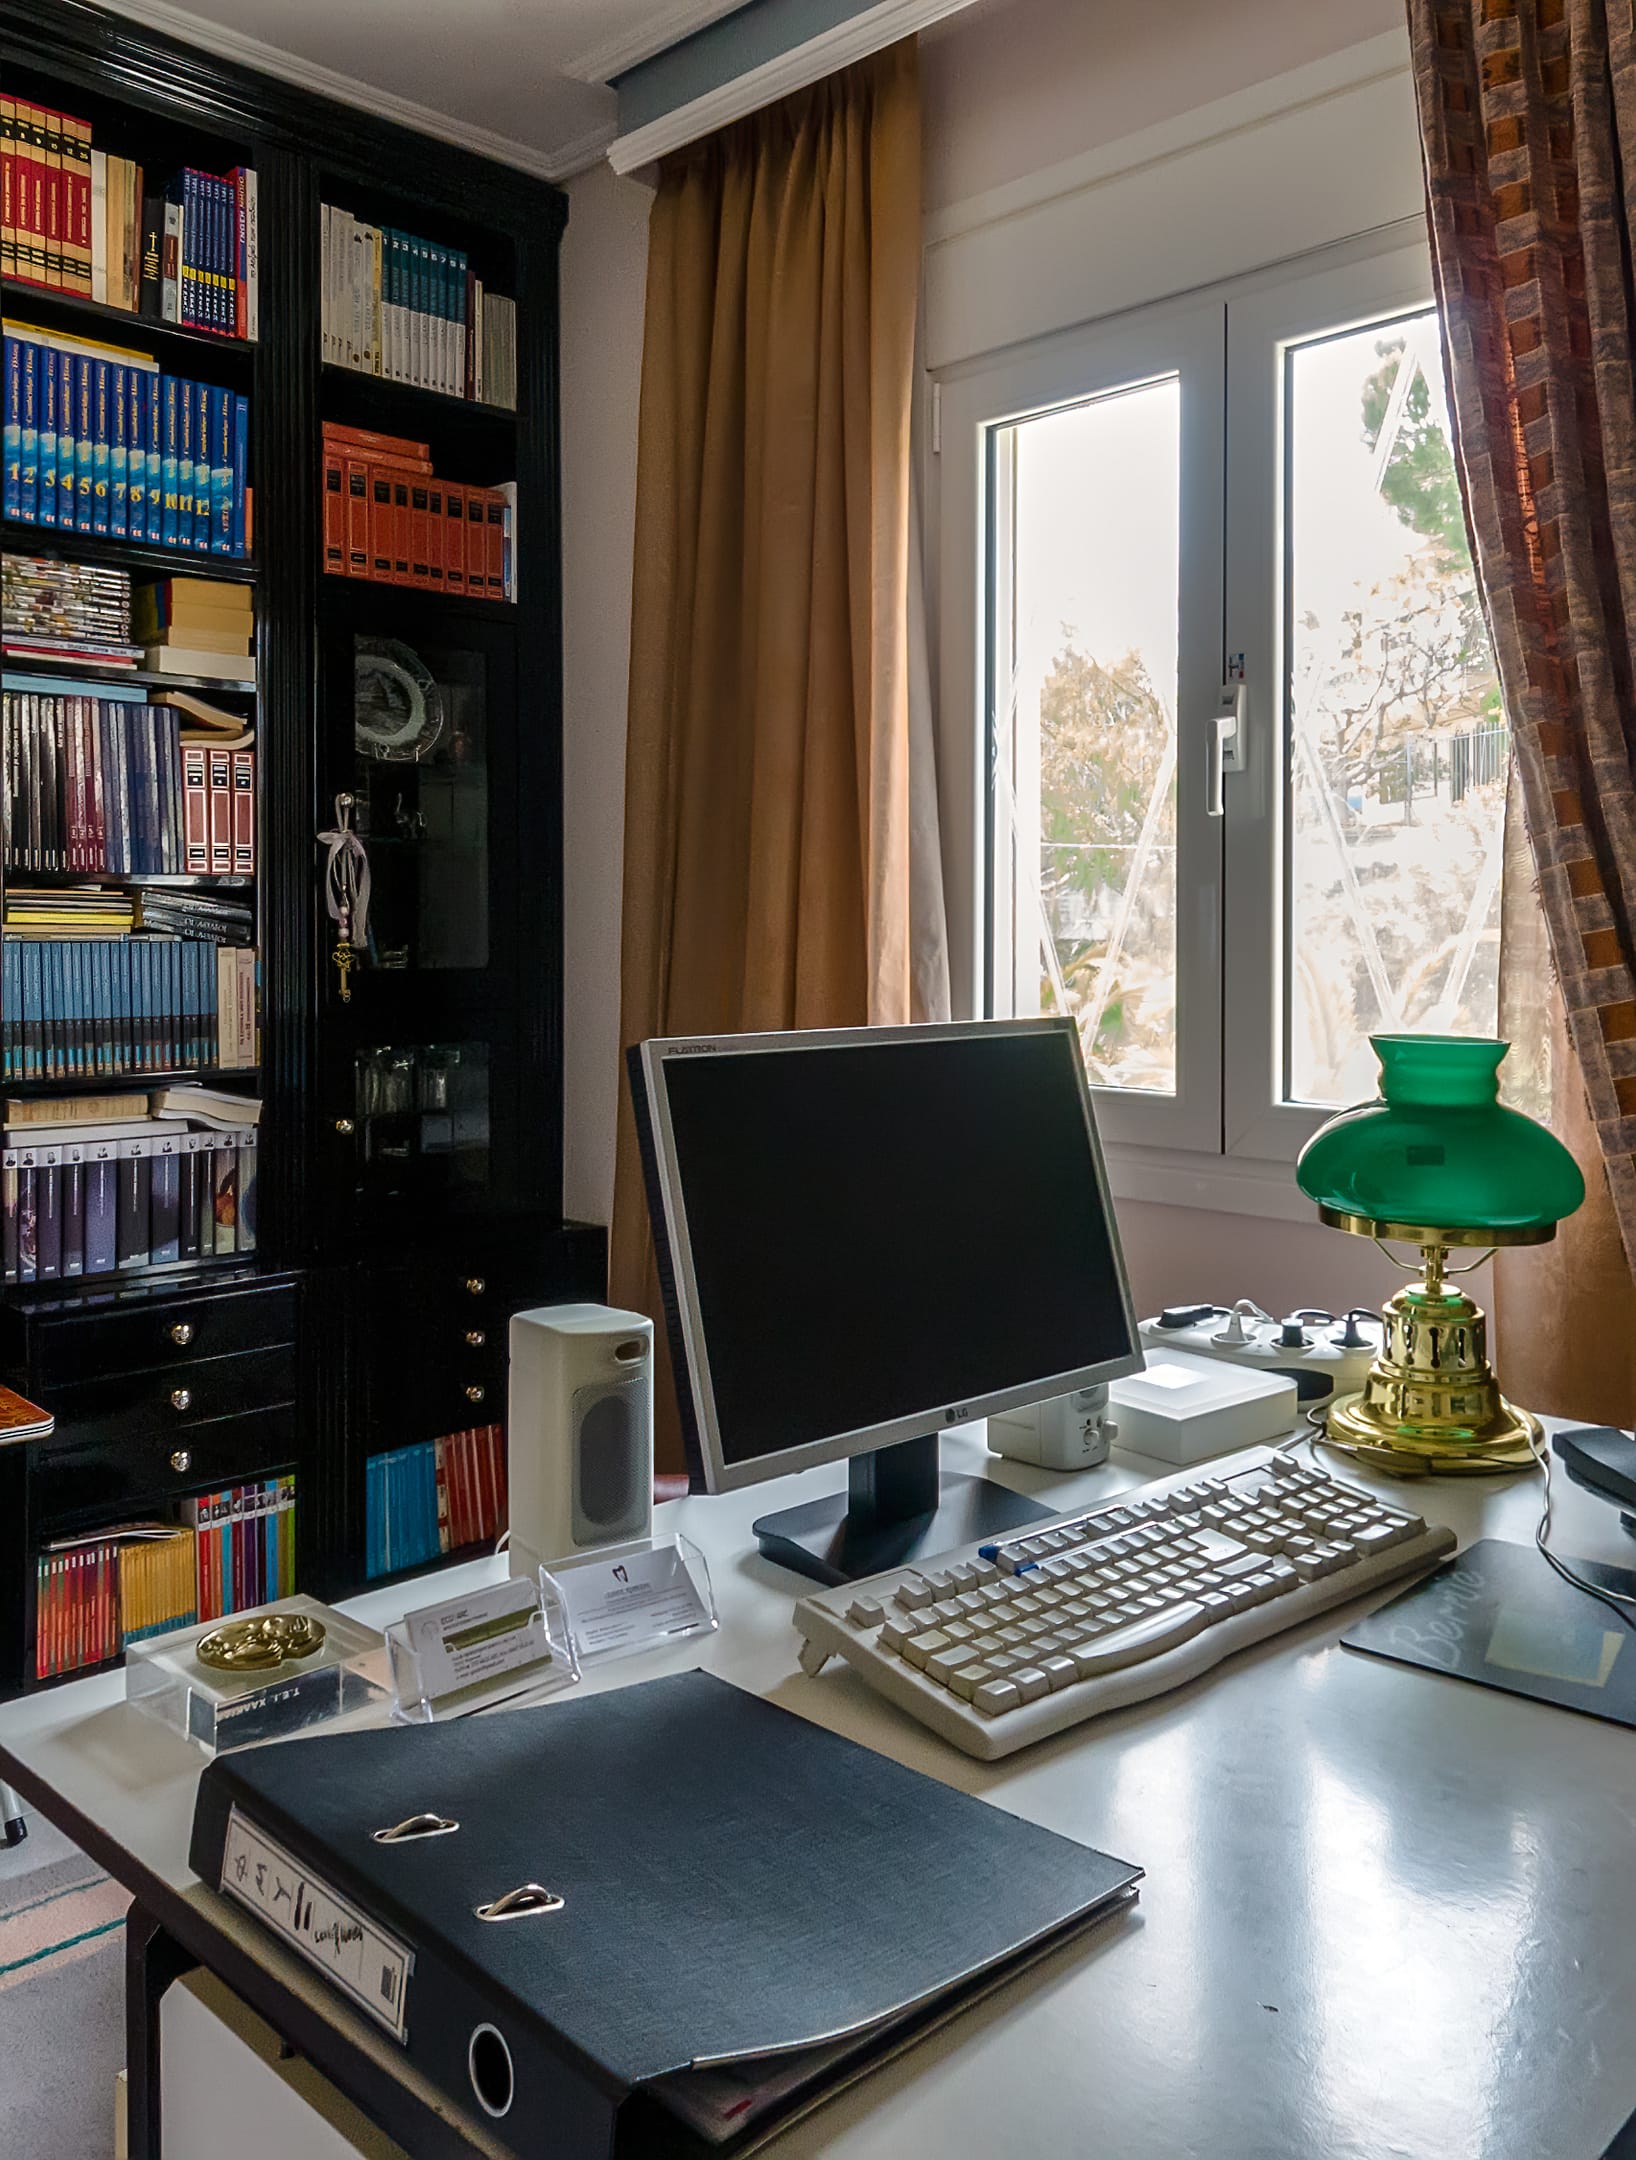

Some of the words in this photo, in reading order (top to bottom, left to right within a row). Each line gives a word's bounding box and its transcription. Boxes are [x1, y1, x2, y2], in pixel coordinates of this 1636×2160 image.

[11, 463, 19, 481] 1
[24, 467, 34, 484] 2
[45, 469, 55, 488] 3
[61, 473, 73, 491] 4
[80, 477, 90, 495] 5
[95, 481, 106, 497] 6
[115, 483, 126, 499] 7
[130, 486, 142, 502] 8
[149, 489, 160, 504] 9
[165, 492, 178, 510] 10
[179, 495, 193, 512] 11
[196, 499, 210, 516] 12
[668, 1044, 716, 1054] FLATRON
